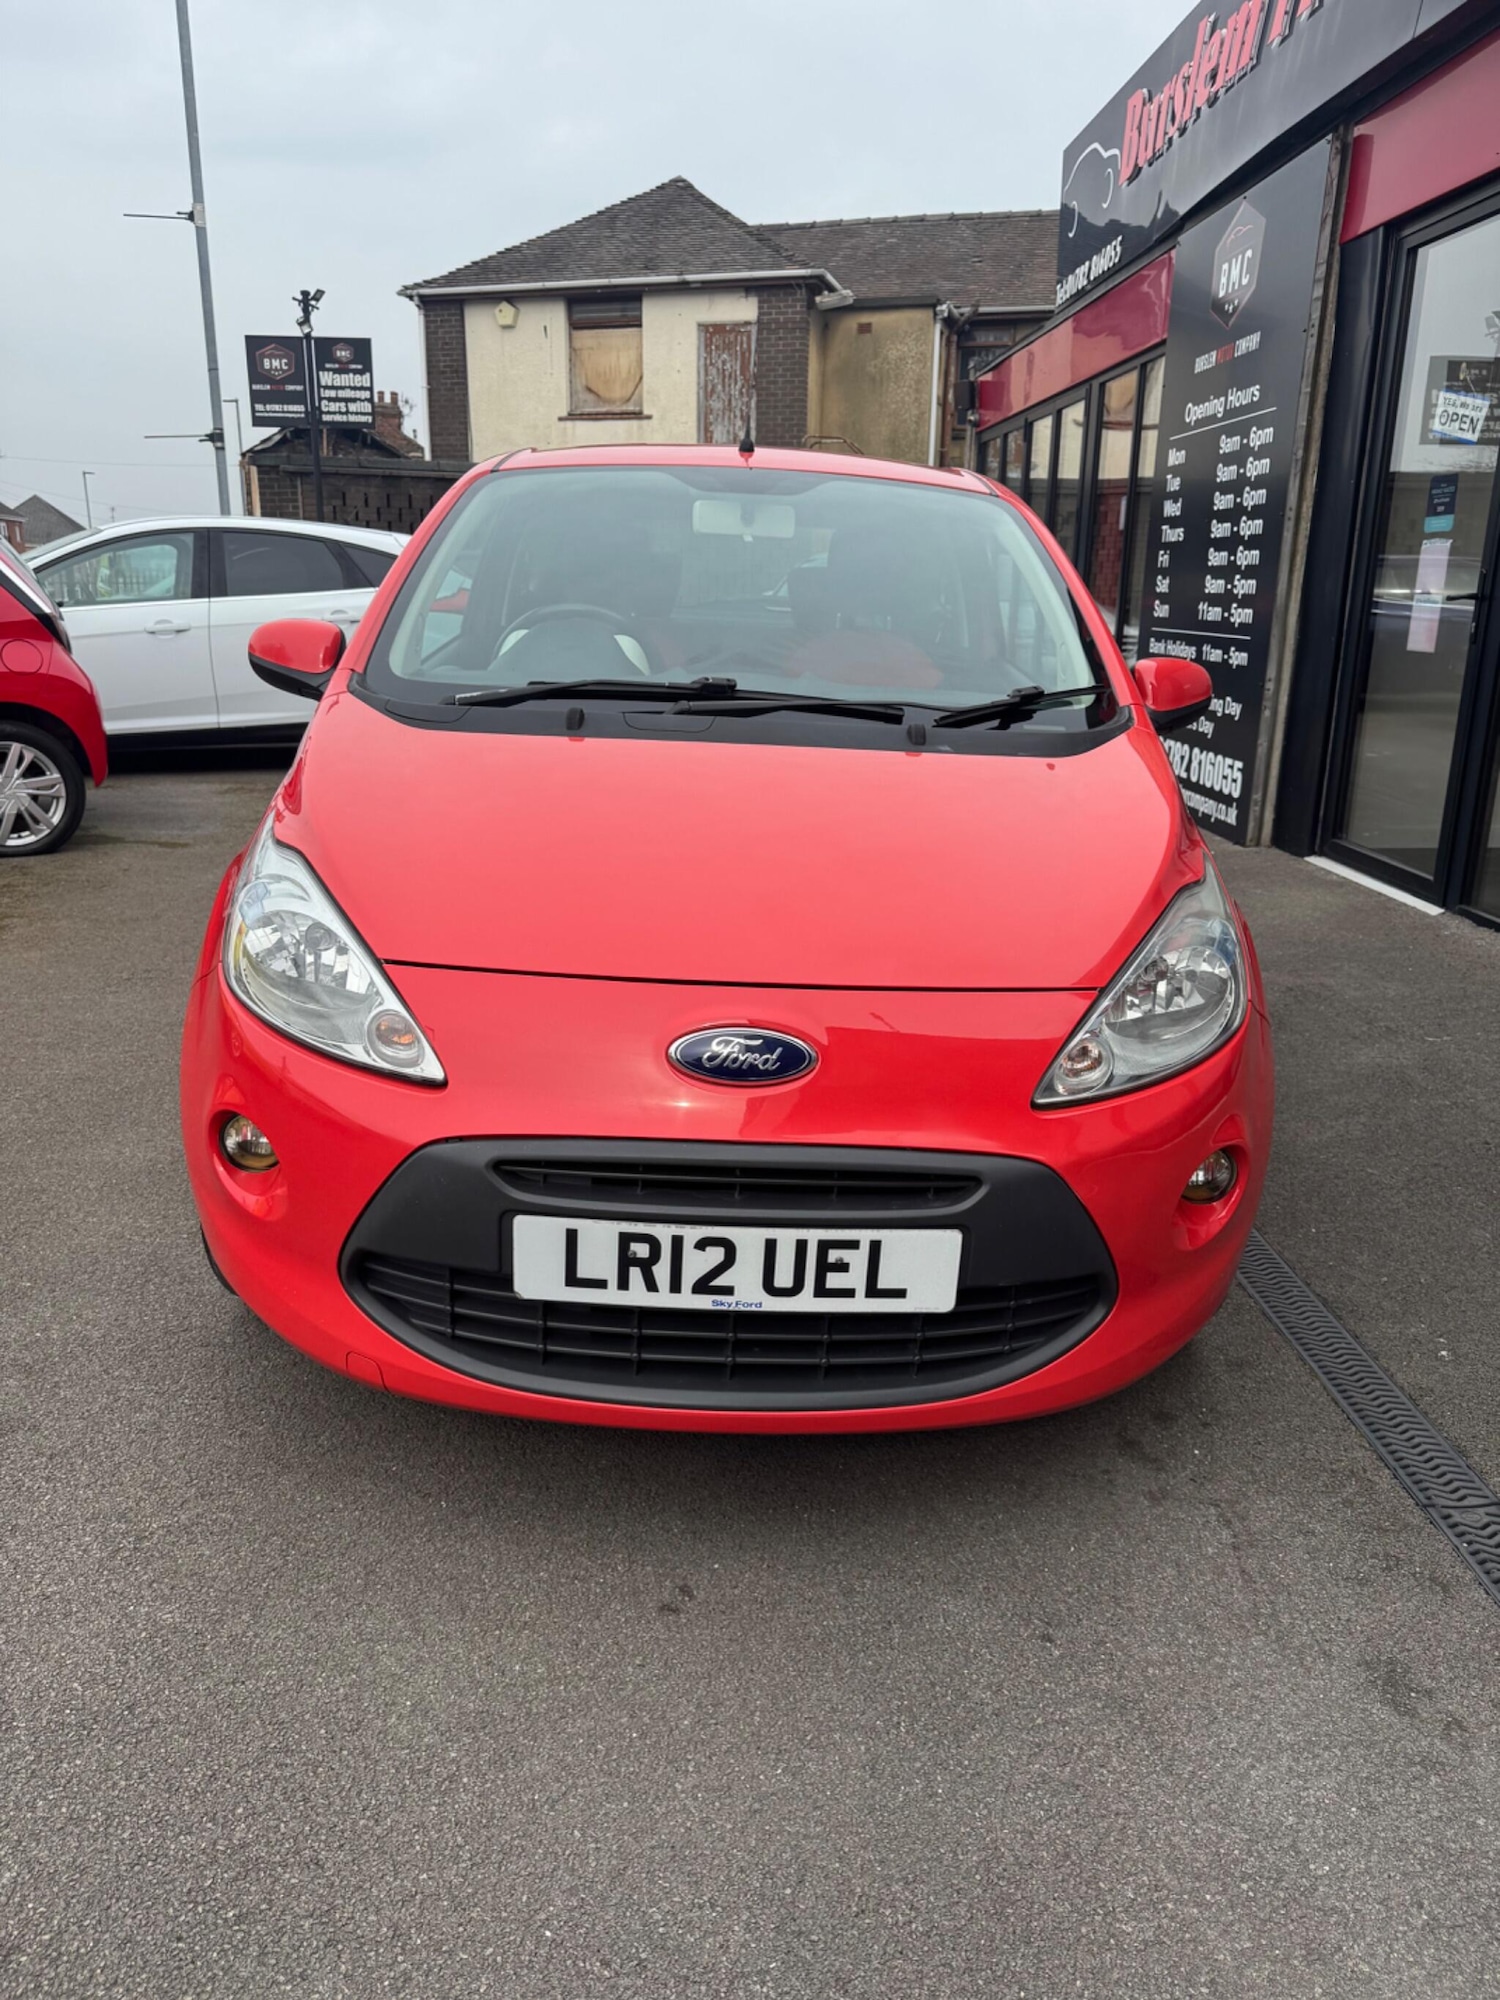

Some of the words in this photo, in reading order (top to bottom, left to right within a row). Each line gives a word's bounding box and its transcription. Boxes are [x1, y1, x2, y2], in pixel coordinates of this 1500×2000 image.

[1119, 0, 1264, 186] Burslem
[1090, 235, 1122, 281] 816055
[1218, 249, 1253, 299] BMC
[263, 358, 289, 370] BMC
[319, 371, 371, 387] Wanted
[320, 388, 336, 398] Low
[337, 388, 370, 400] mileage
[321, 400, 347, 412] Cars
[347, 400, 372, 413] with
[1185, 395, 1225, 426] Opening
[1226, 384, 1261, 410] Hours
[1443, 396, 1458, 409] YES,
[322, 413, 347, 422] service
[347, 413, 373, 423] history
[1439, 409, 1480, 435] OPEN
[1167, 448, 1186, 467] Mon
[1219, 434, 1241, 454] 9am
[1249, 426, 1274, 452] 6pm
[1166, 474, 1181, 492] Tue
[1216, 463, 1238, 483] 9am
[1246, 456, 1270, 481] 6pm
[1163, 497, 1182, 518] Wed
[1213, 491, 1234, 511] 9am
[1242, 486, 1267, 511] 6pm
[1161, 525, 1184, 543] Thurs
[1210, 519, 1231, 539] 9am
[1239, 516, 1263, 541] 6pm
[1158, 550, 1170, 568] Fri
[1207, 547, 1228, 567] 9am
[1236, 545, 1260, 570] 6pm
[1155, 575, 1170, 593] Sat
[1204, 574, 1225, 594] 9am
[1233, 574, 1257, 599] 5pm
[1153, 600, 1170, 618] Sun
[1198, 601, 1222, 622] 11am
[1230, 603, 1254, 628] 5pm
[1149, 637, 1165, 655] Bank
[1166, 639, 1197, 661] Holidays
[1202, 643, 1223, 663] 11am
[1228, 646, 1249, 669] 5pm
[1208, 693, 1224, 717] ing
[1224, 696, 1242, 721] Day
[1198, 716, 1215, 739] Day
[1159, 735, 1190, 779] 782
[1189, 746, 1244, 799] 816055
[701, 1036, 783, 1070] Ford
[564, 1228, 737, 1296] LR12
[762, 1238, 908, 1299] UEL
[711, 1299, 733, 1309] Sky
[735, 1300, 763, 1309] Ford
